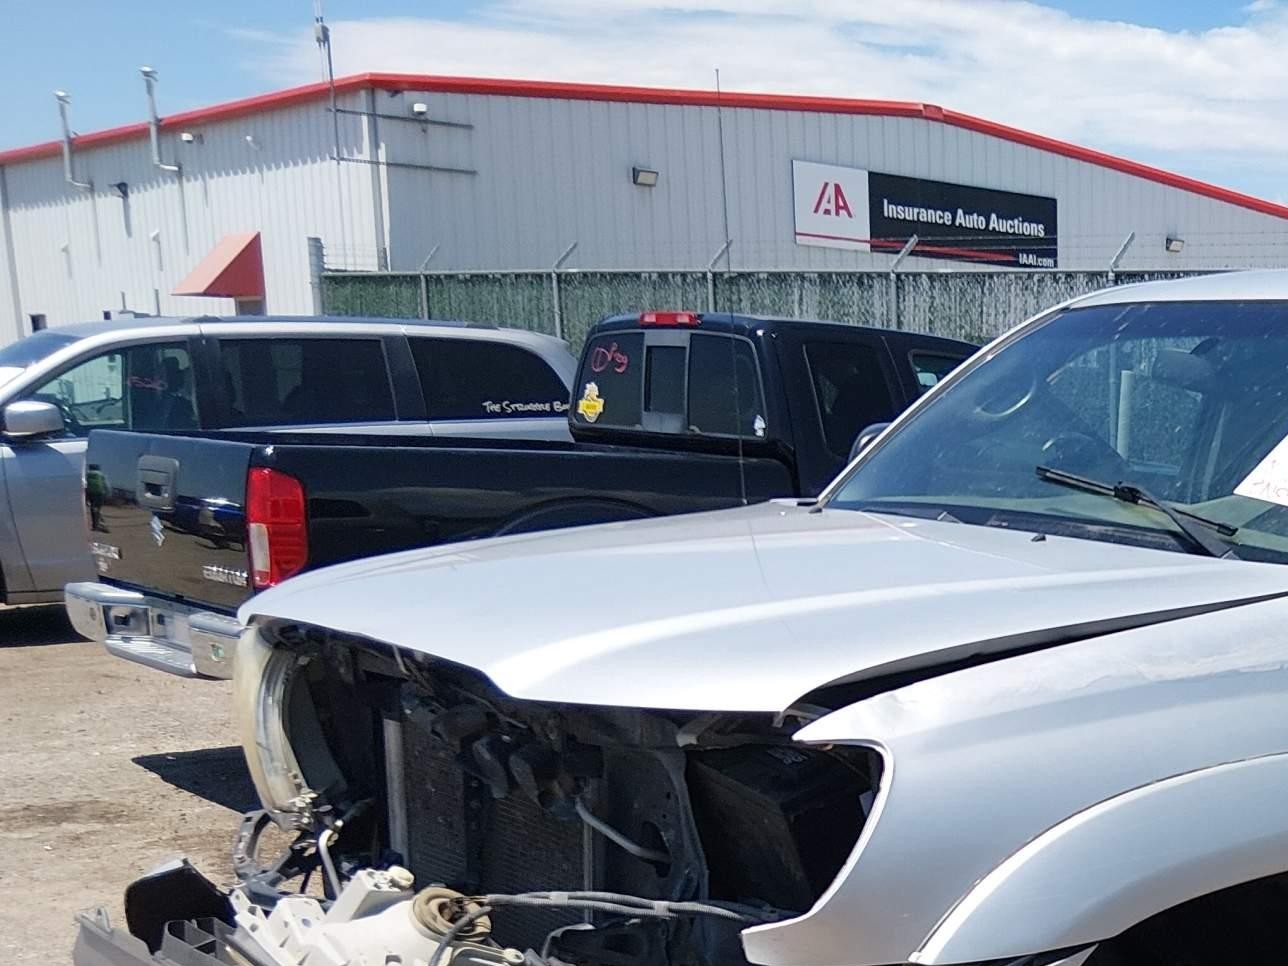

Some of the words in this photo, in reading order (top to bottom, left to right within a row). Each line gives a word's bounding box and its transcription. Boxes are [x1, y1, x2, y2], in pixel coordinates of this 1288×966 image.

[883, 199, 951, 226] Insurance
[955, 208, 986, 231] Auto
[988, 213, 1045, 238] Auctions
[1019, 252, 1055, 269] IAAI.com
